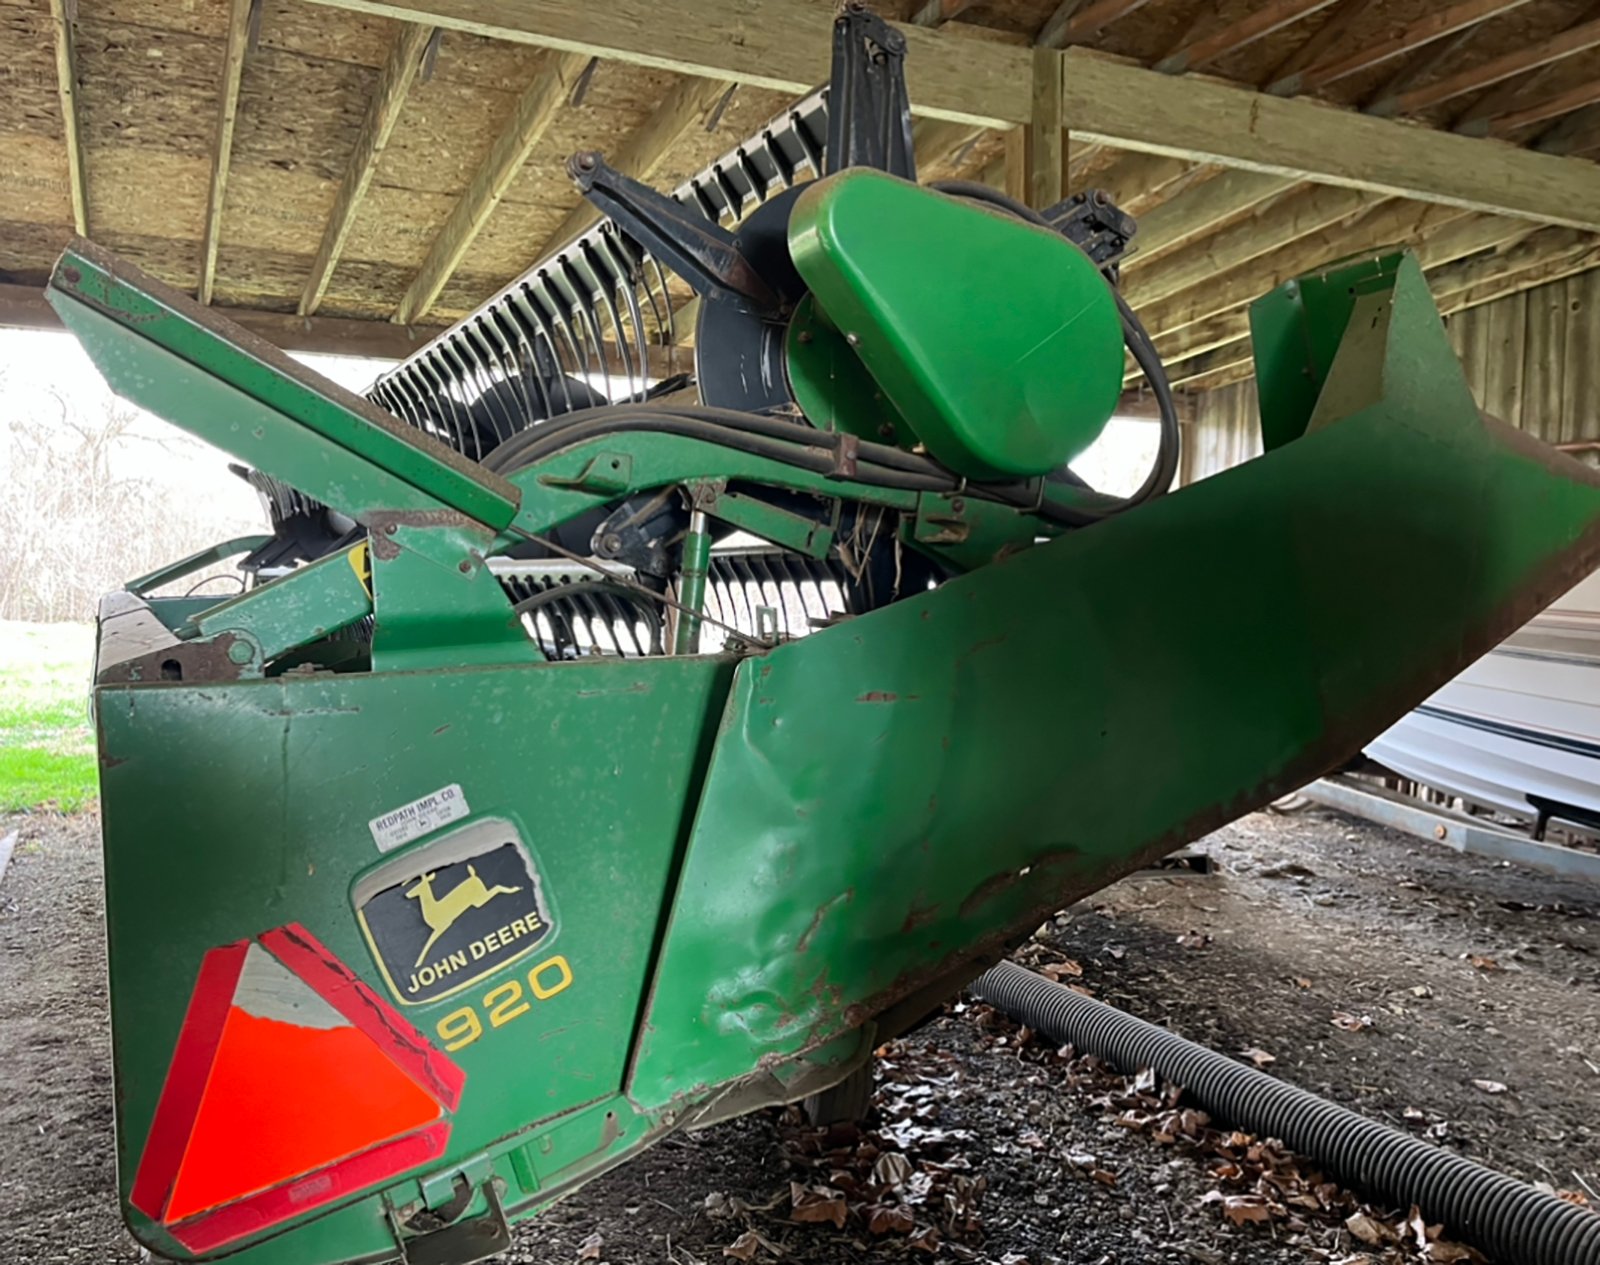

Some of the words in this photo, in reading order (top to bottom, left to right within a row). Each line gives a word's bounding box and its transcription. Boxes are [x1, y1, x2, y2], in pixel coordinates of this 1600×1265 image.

[376, 806, 416, 832] REDPATH
[408, 950, 468, 994] JOHN
[469, 911, 542, 960] DEERE
[436, 955, 574, 1052] 920
